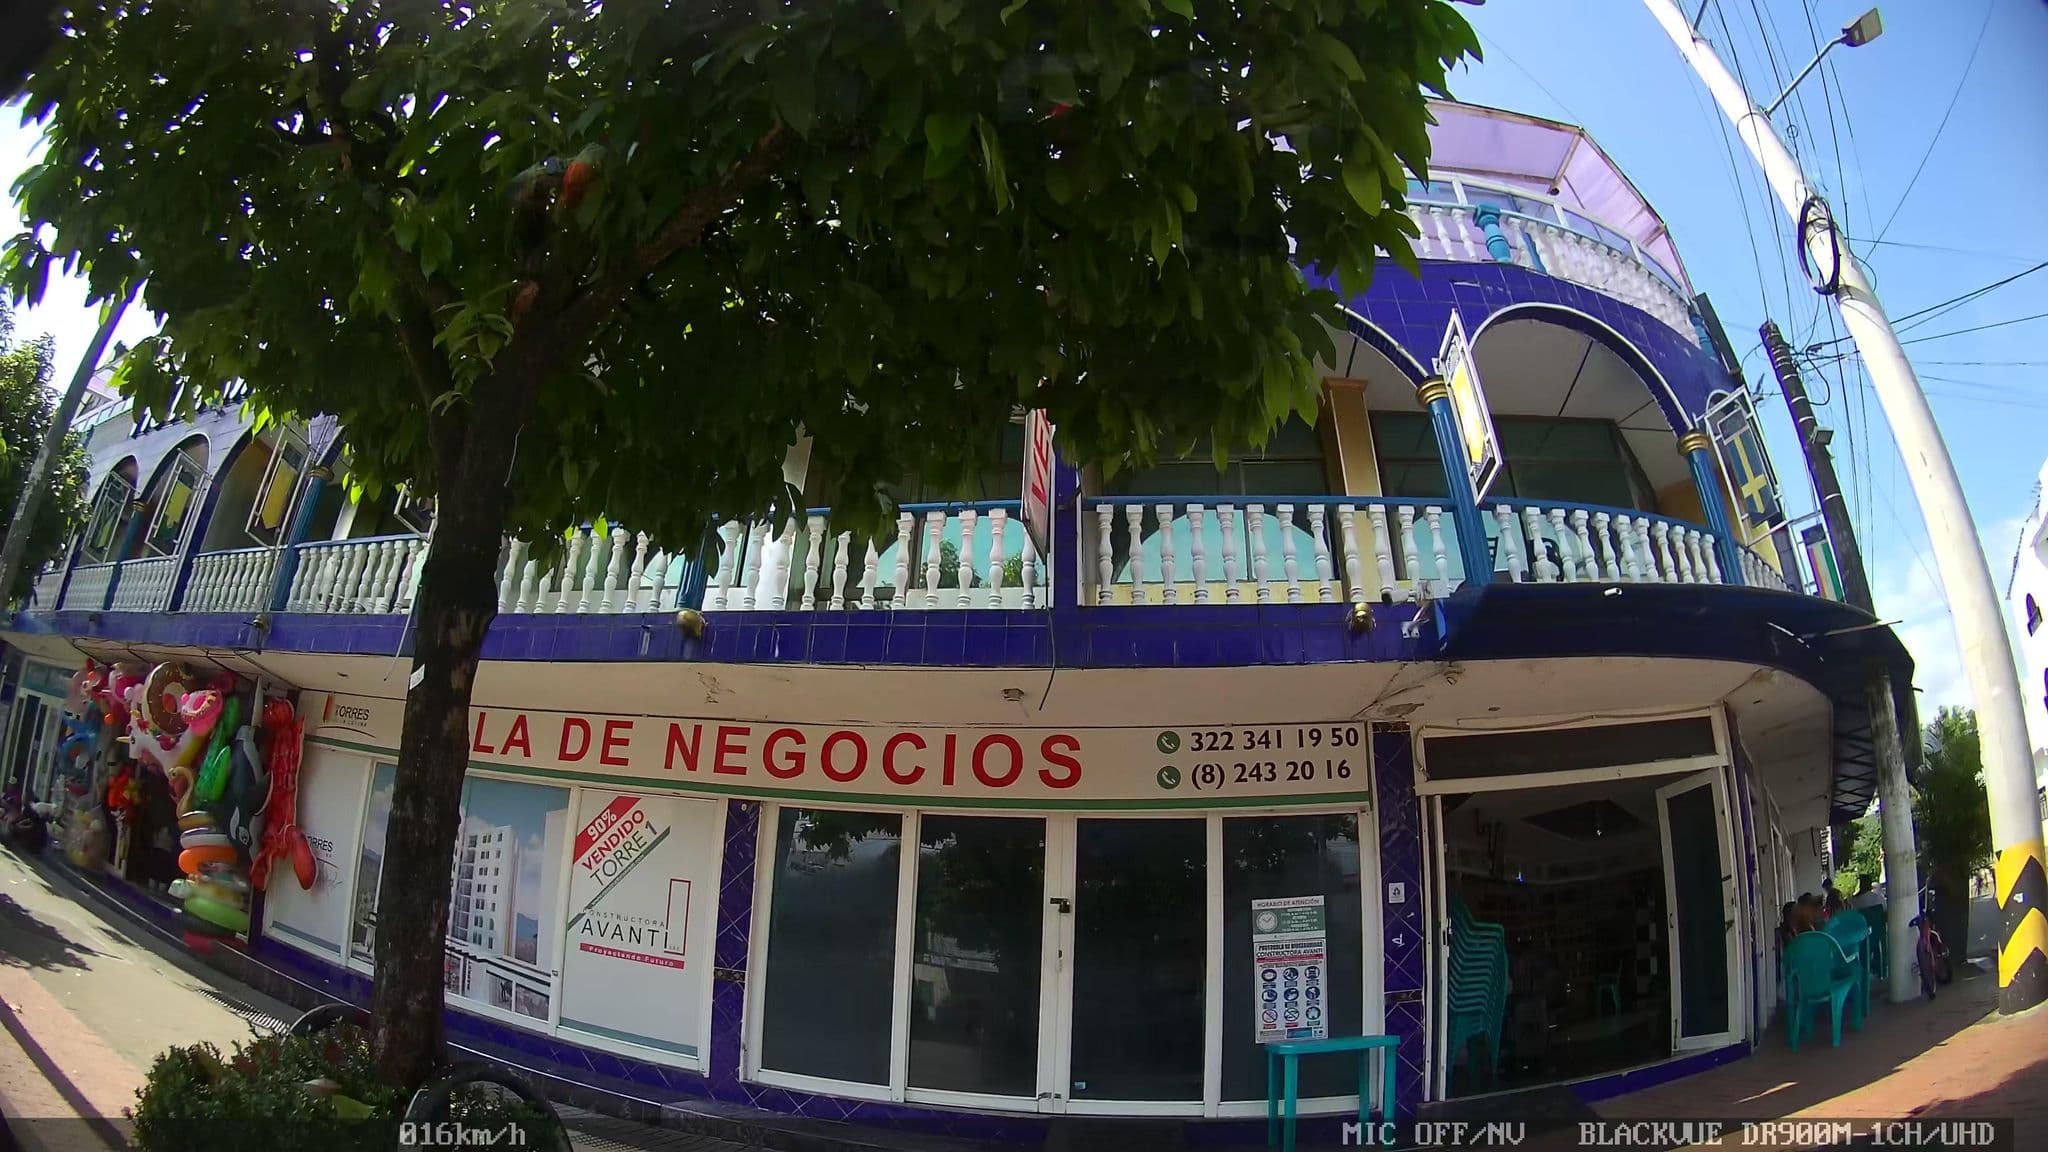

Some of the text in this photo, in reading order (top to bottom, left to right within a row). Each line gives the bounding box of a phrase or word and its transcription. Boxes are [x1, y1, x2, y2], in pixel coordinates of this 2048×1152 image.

[336, 704, 370, 721] TORRES
[558, 716, 634, 767] DE
[664, 722, 1082, 789] NEGOCIOS
[1190, 727, 1360, 752] 322 341 19 50
[1191, 758, 1351, 790] (8) 243 20 16
[581, 809, 645, 872] VENDIDO
[587, 808, 617, 841] 90%
[589, 830, 648, 887] TORRE
[645, 820, 658, 836] 1
[581, 918, 669, 949] AVANTI
[588, 945, 675, 968] Proyectando Futuro
